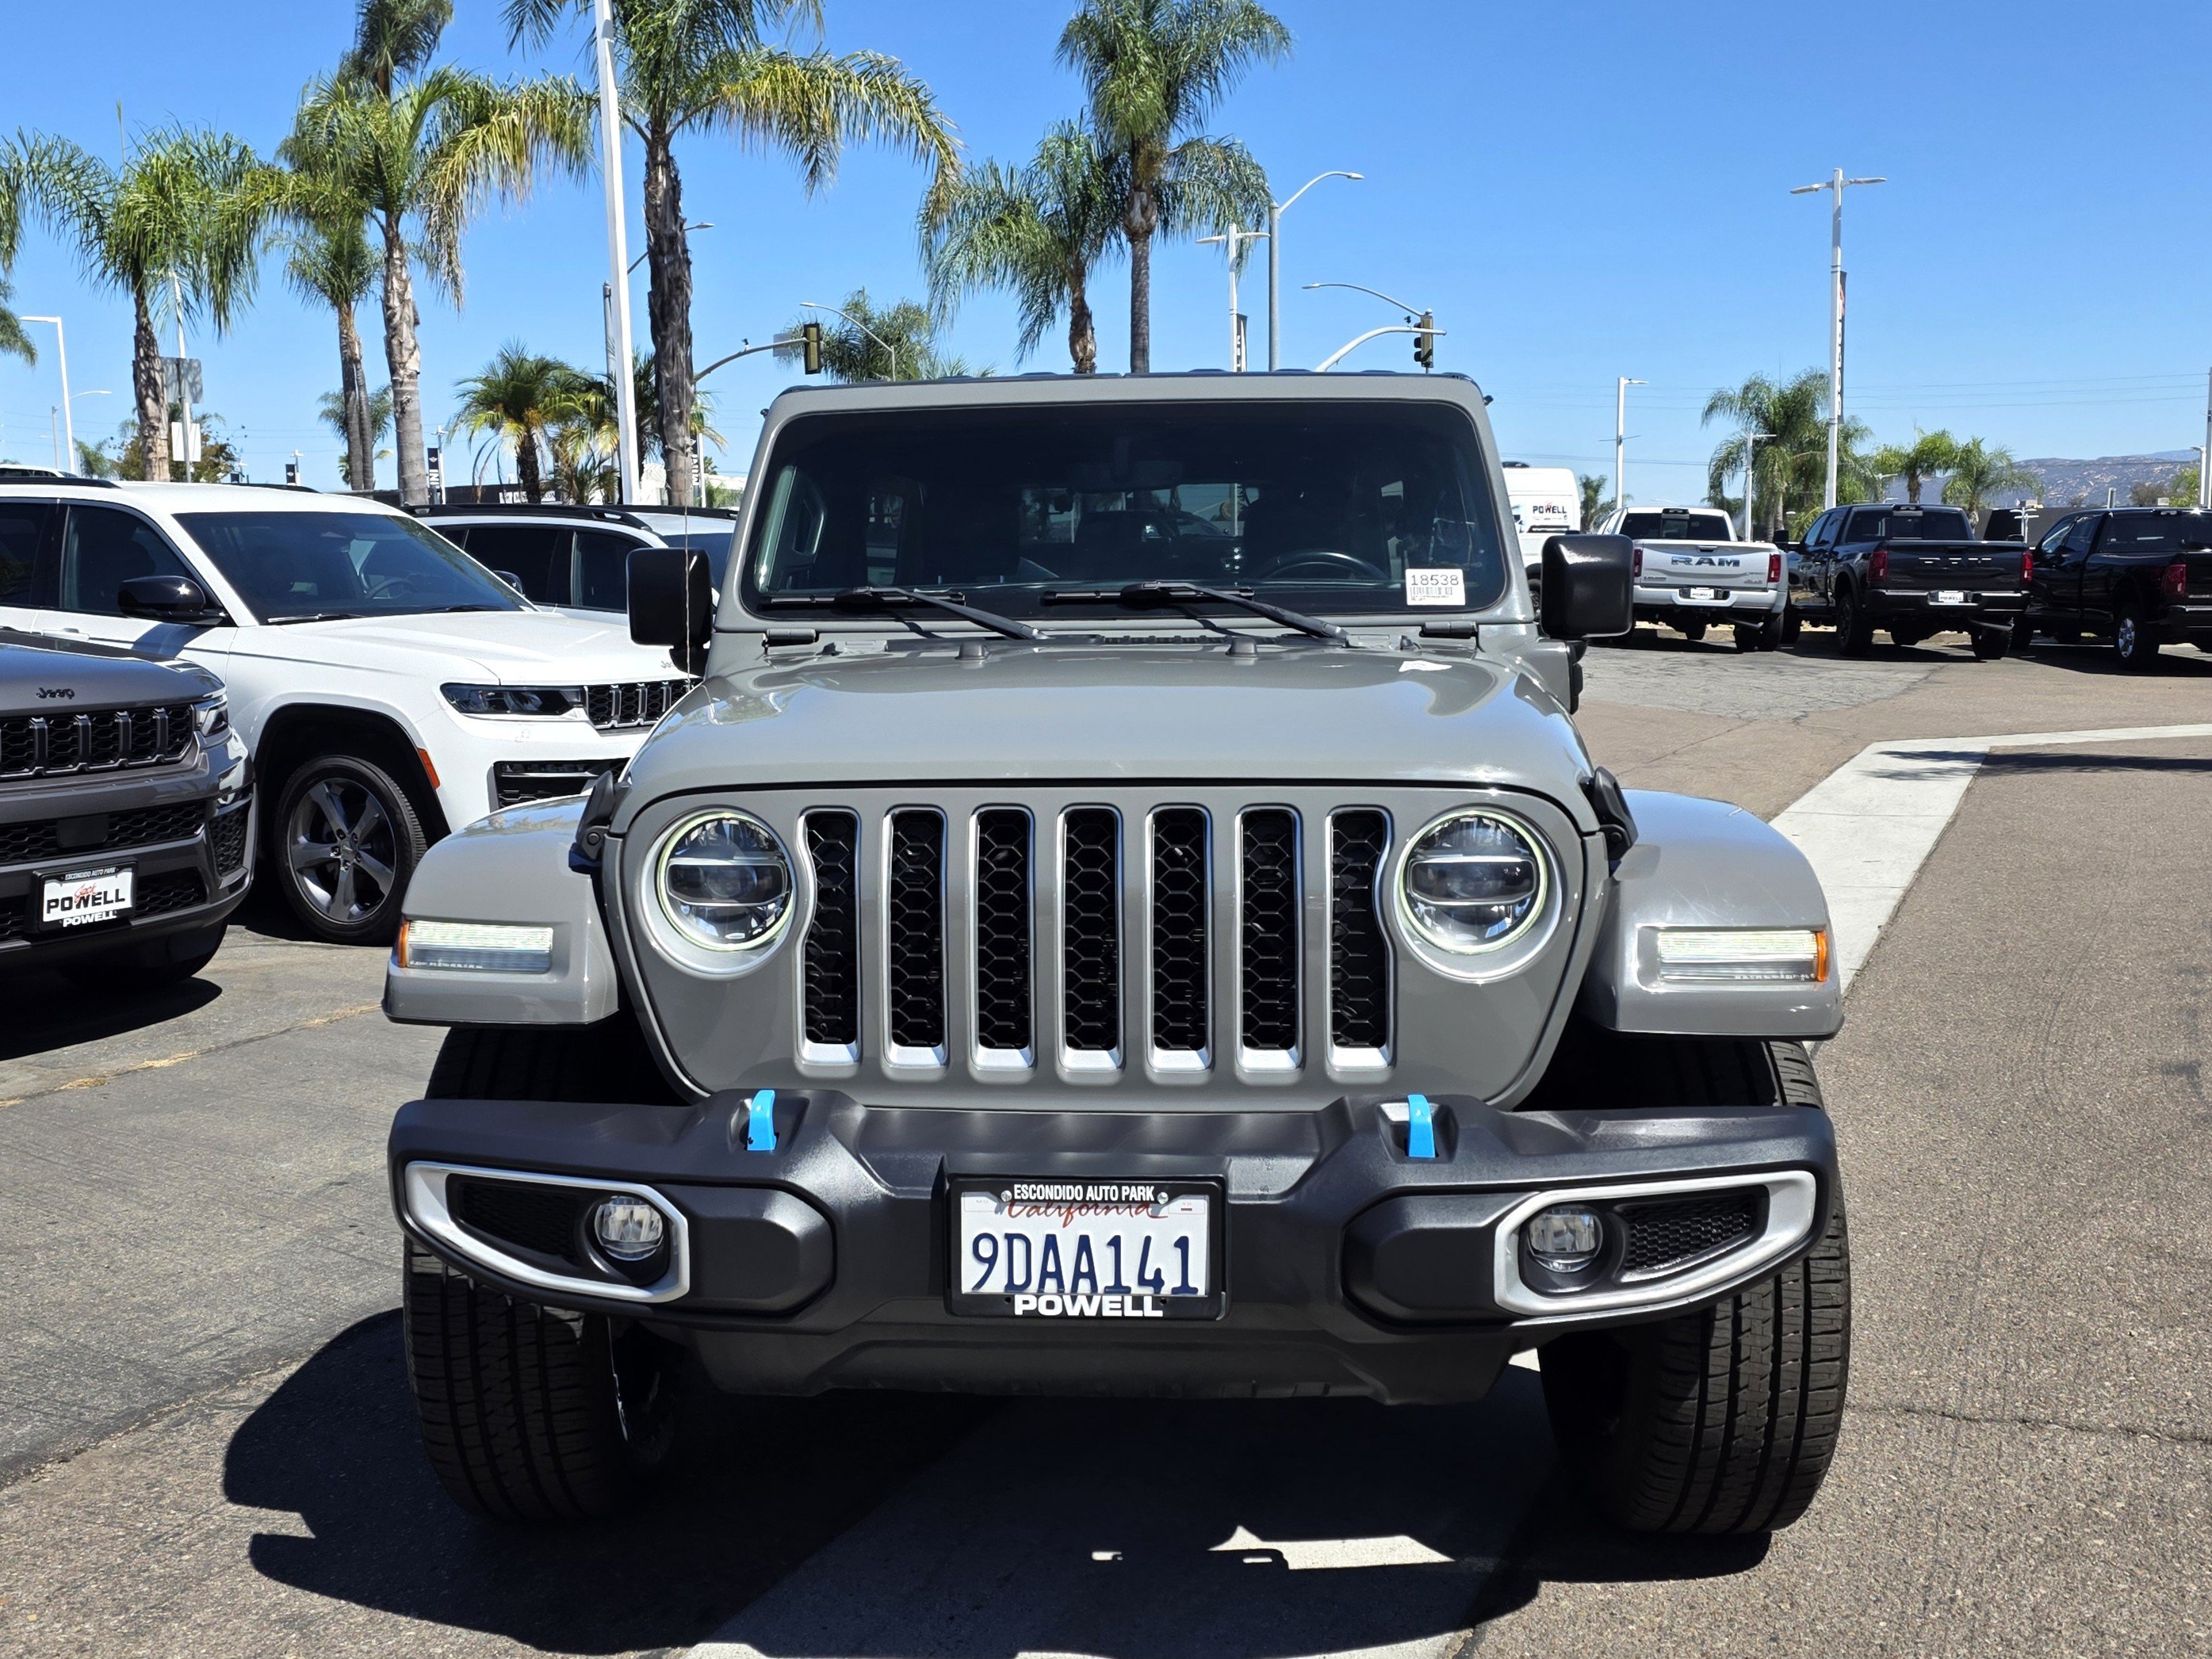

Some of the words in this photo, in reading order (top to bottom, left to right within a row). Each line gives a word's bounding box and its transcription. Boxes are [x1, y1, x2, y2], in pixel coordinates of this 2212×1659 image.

[429, 469, 440, 485] INI
[1533, 505, 1567, 514] POWELL
[1670, 556, 1740, 568] RAM
[1410, 574, 1460, 586] 18538
[36, 686, 75, 700] Jeep
[46, 888, 125, 915] POWELL
[63, 910, 117, 927] POWELL
[1013, 1184, 1084, 1200] ESCONDIDO
[1085, 1185, 1120, 1202] AUTO
[1123, 1186, 1155, 1202] PARK
[971, 1232, 1199, 1295] 9DAA141
[1014, 1294, 1164, 1317] POWELL
